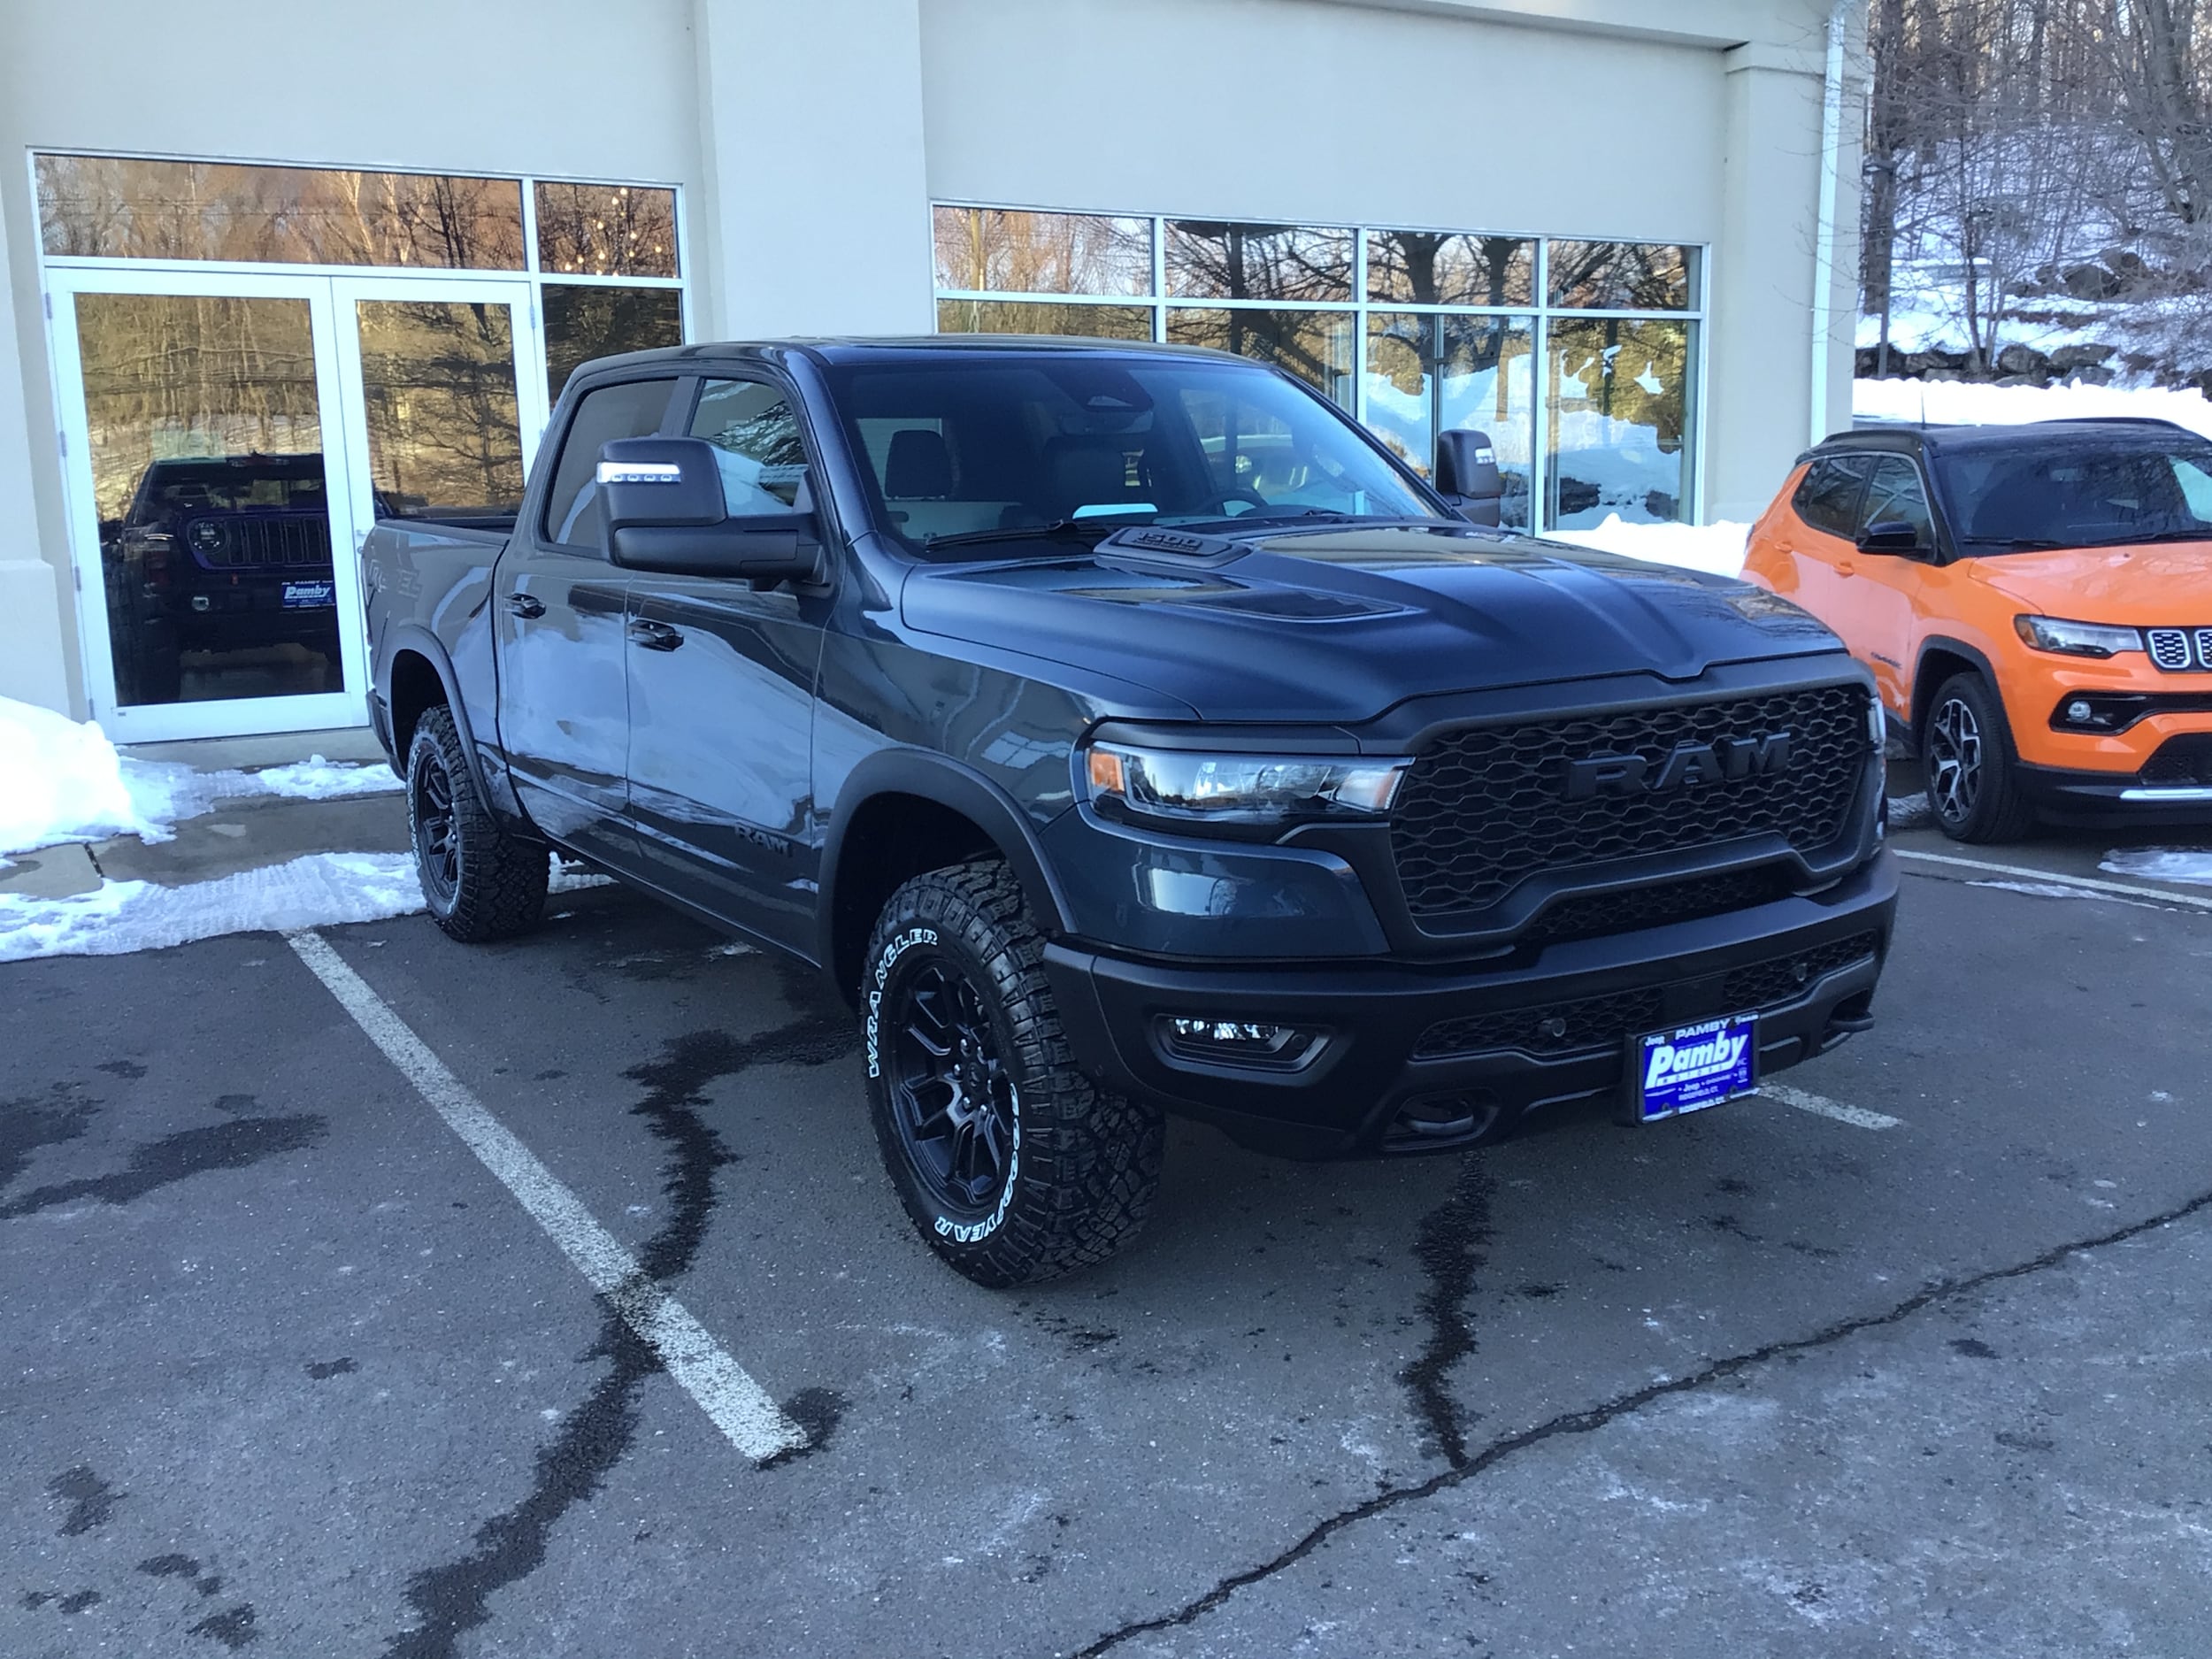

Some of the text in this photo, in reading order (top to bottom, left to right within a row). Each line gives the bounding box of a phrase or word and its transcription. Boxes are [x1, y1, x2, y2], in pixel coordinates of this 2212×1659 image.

[1136, 532, 1202, 549] 1500
[284, 585, 331, 599] Pamby
[1568, 732, 1791, 797] RAM
[734, 826, 790, 855] RAM
[866, 928, 938, 1078] WRANGLER
[1675, 1019, 1730, 1040] PAMBY
[1644, 1030, 1748, 1090] Pamby
[934, 1083, 1020, 1242] GOODYEAR
